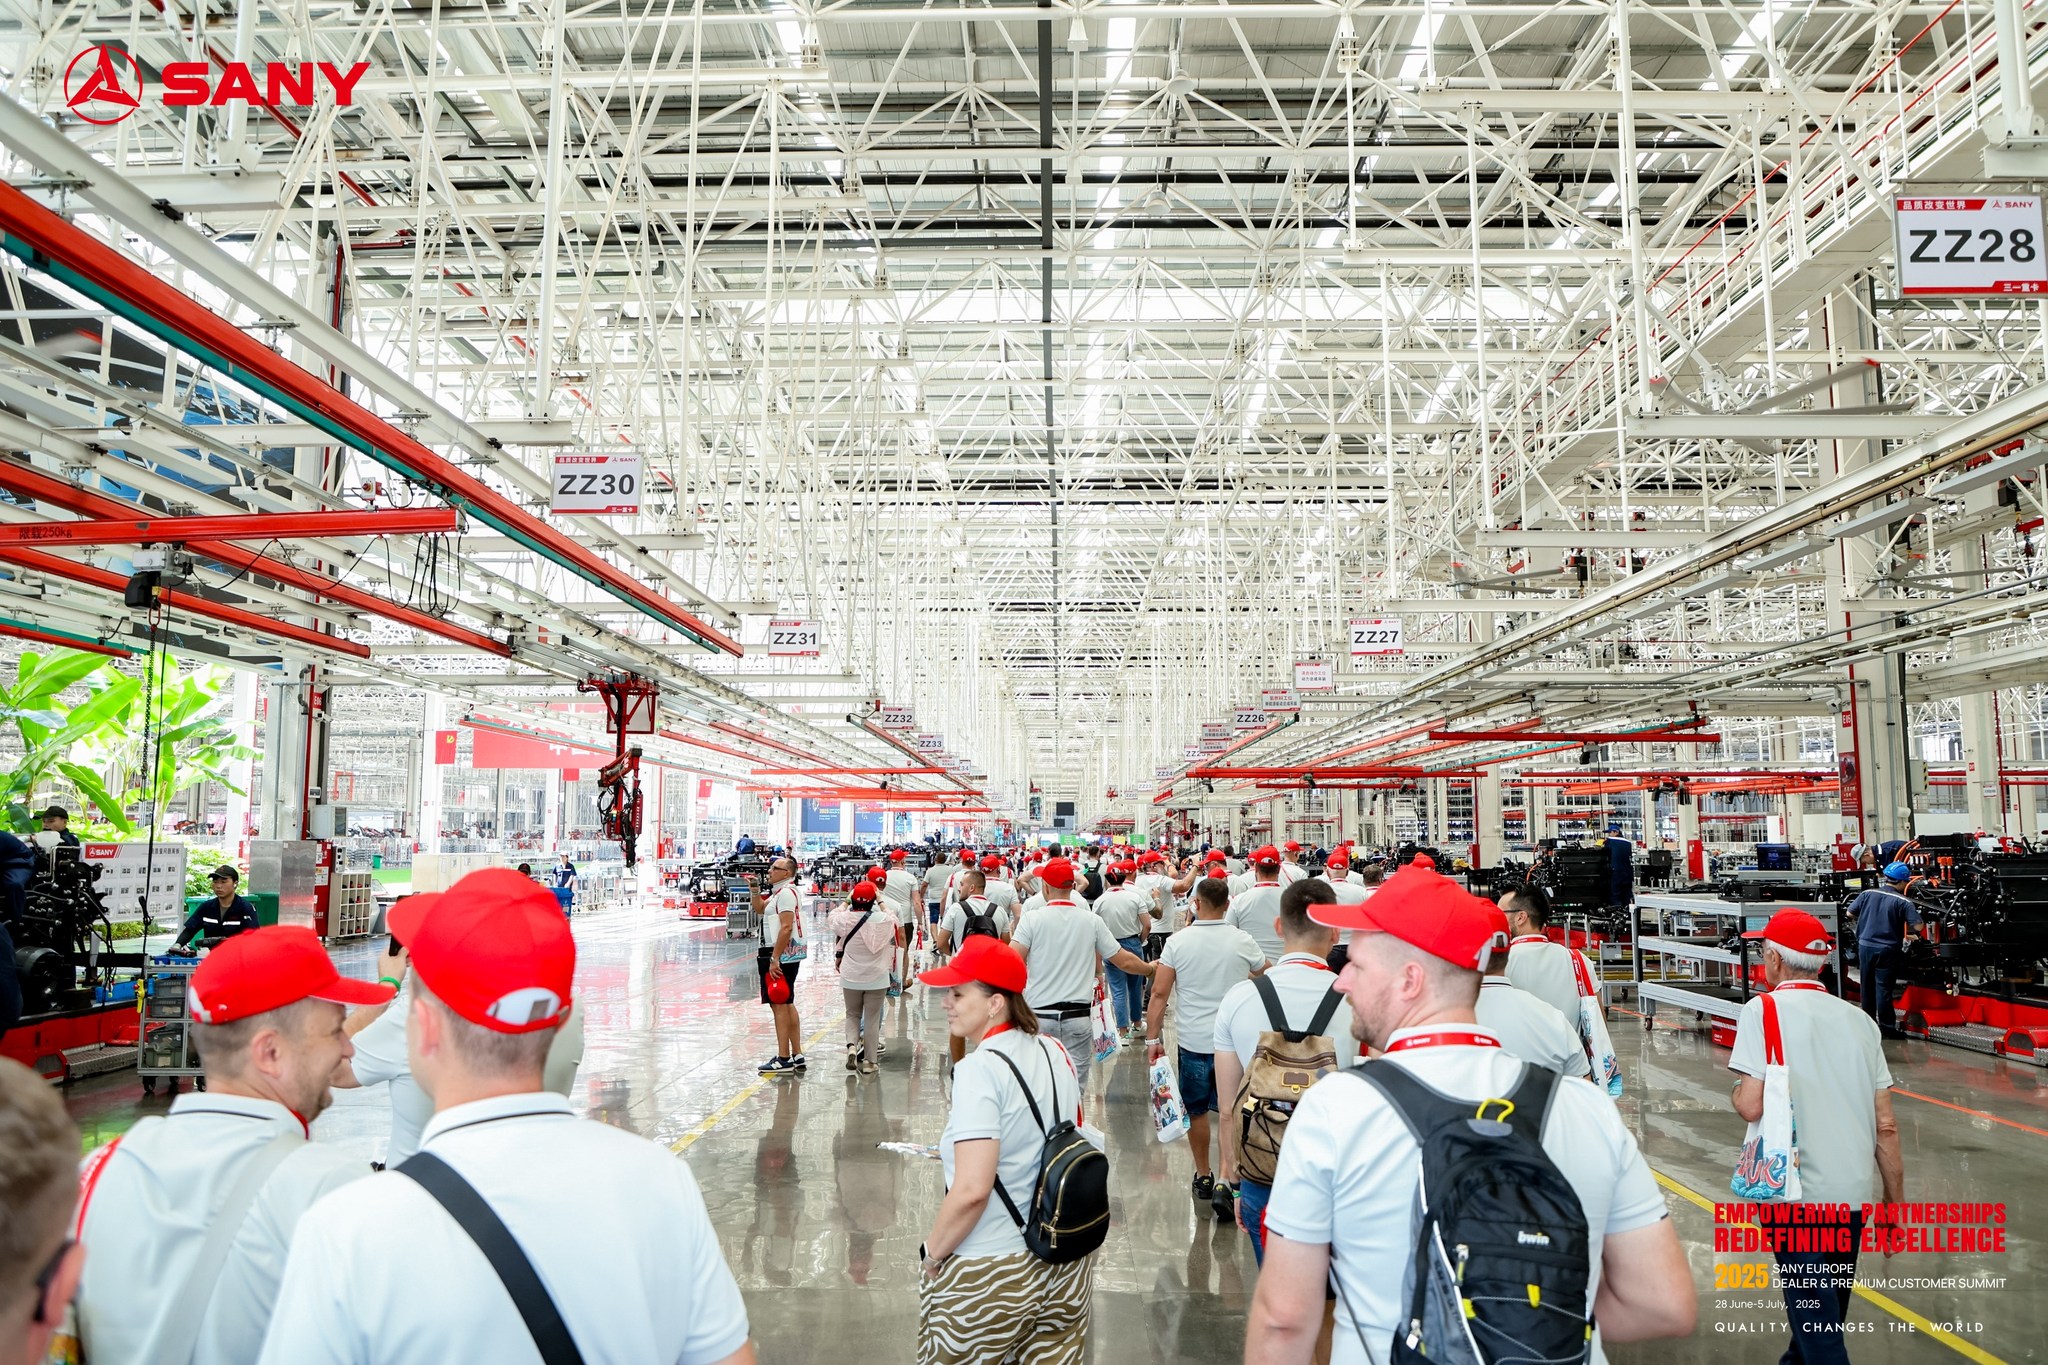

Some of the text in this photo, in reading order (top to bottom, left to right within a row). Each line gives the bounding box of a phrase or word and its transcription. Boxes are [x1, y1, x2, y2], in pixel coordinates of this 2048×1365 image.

[1903, 200, 1966, 210] 品质改变世界
[1909, 229, 2036, 263] ZZ28
[2003, 283, 2039, 292] 三一重卡
[558, 474, 635, 495] ZZ30
[773, 632, 816, 645] ZZ31
[1354, 630, 1399, 644] ZZ27
[885, 715, 913, 723] ZZ32
[1237, 714, 1265, 723] ZZ26
[96, 848, 114, 856] SANY
[1517, 1230, 1550, 1246] bwin
